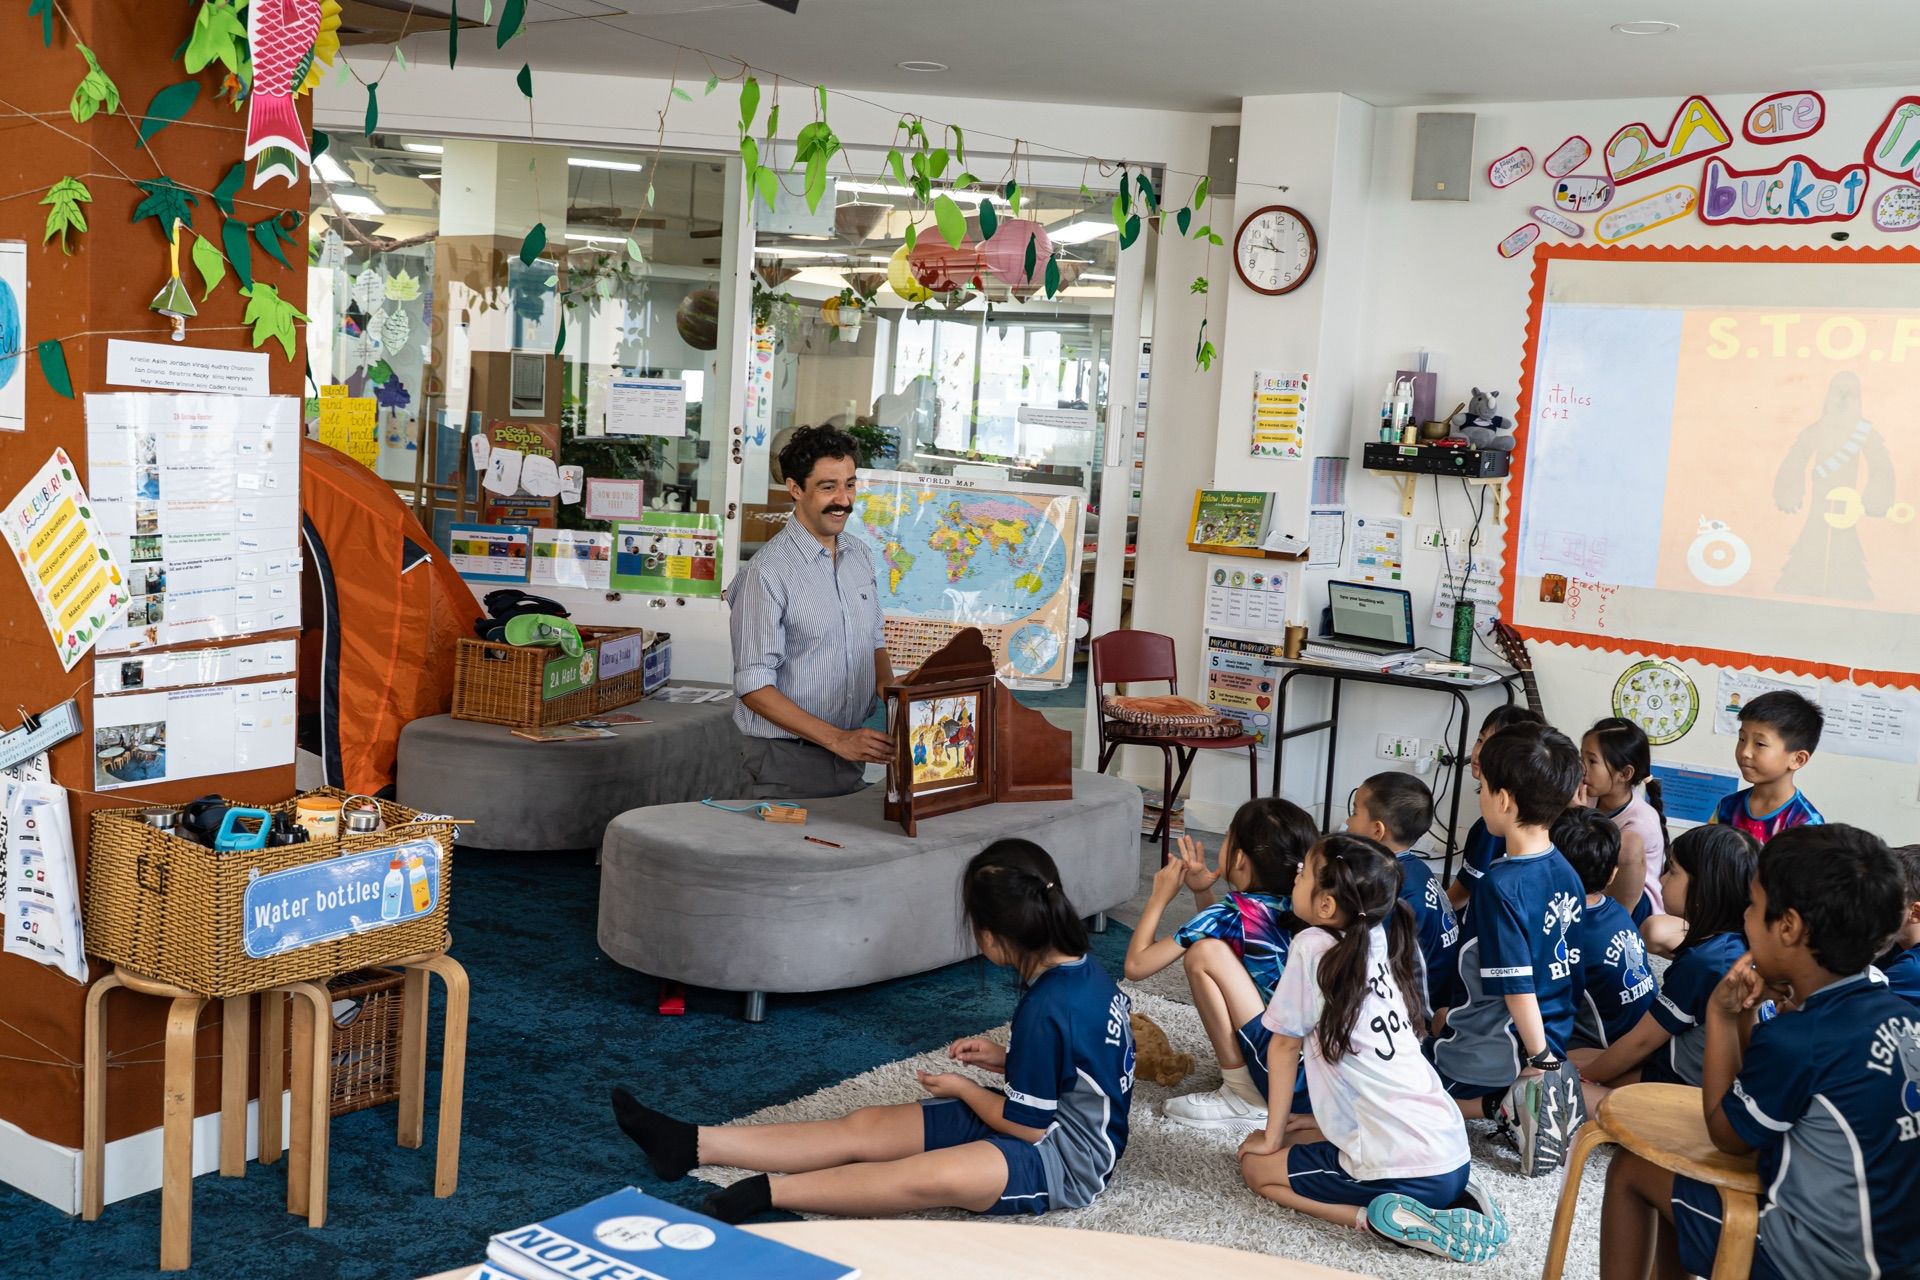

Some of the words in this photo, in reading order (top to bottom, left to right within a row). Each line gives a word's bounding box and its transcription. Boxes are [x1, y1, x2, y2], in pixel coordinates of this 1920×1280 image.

[1609, 100, 1728, 179] 2A
[1753, 97, 1819, 133] are
[1707, 162, 1863, 217] bucket
[1262, 219, 1270, 229] 11
[1275, 216, 1285, 226] 12
[1290, 221, 1295, 231] 1
[1251, 230, 1261, 239] 10
[1297, 233, 1305, 242] 2
[1300, 248, 1308, 257] 3
[1248, 259, 1256, 269] 8
[1294, 263, 1302, 272] 4
[1258, 271, 1264, 280] 7
[1269, 276, 1277, 285] 6
[1284, 272, 1292, 282] 5
[1549, 384, 1591, 406] italics
[506, 426, 527, 434] Good
[495, 430, 541, 446] People
[918, 476, 951, 485] WORLD
[18, 474, 62, 527] REMEMBER!
[36, 537, 46, 549] Ask
[62, 572, 79, 589] bucket
[68, 603, 82, 618] Make
[1598, 604, 1606, 613] 5
[1598, 617, 1605, 628] 6
[1212, 656, 1219, 666] 5
[550, 672, 559, 688] 2A
[562, 667, 577, 682] Hats
[1210, 673, 1217, 683] 4
[1209, 690, 1216, 700] 3
[255, 897, 309, 929] Water
[317, 881, 380, 912] bottles
[1490, 968, 1519, 976] COGNITA
